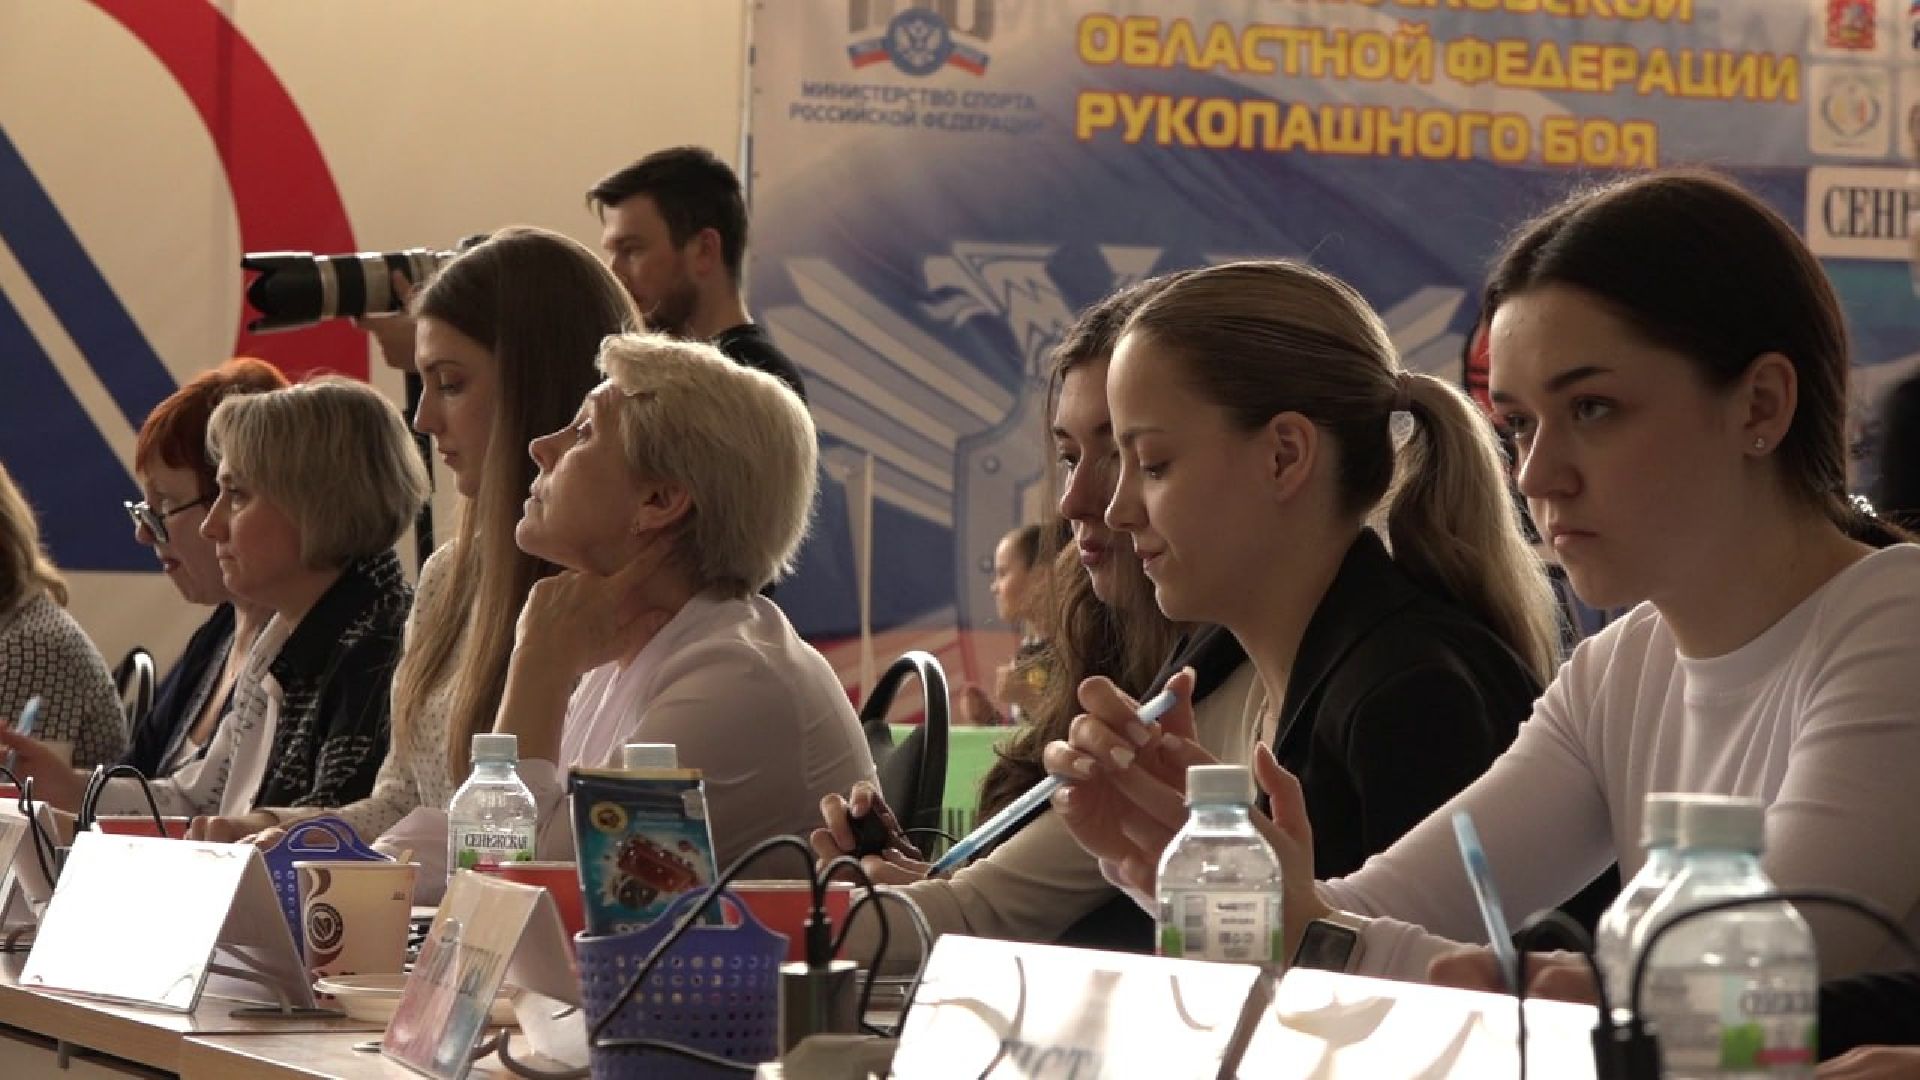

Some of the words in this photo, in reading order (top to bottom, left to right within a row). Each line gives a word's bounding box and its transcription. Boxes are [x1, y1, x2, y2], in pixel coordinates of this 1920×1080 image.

[1078, 15, 1434, 83] ОБЛАСТНОЙ
[1445, 36, 1800, 103] ФЕДЕРАЦИИ
[1076, 91, 1530, 164] РУКОПАШНОГО
[1542, 116, 1658, 168] БОЯ
